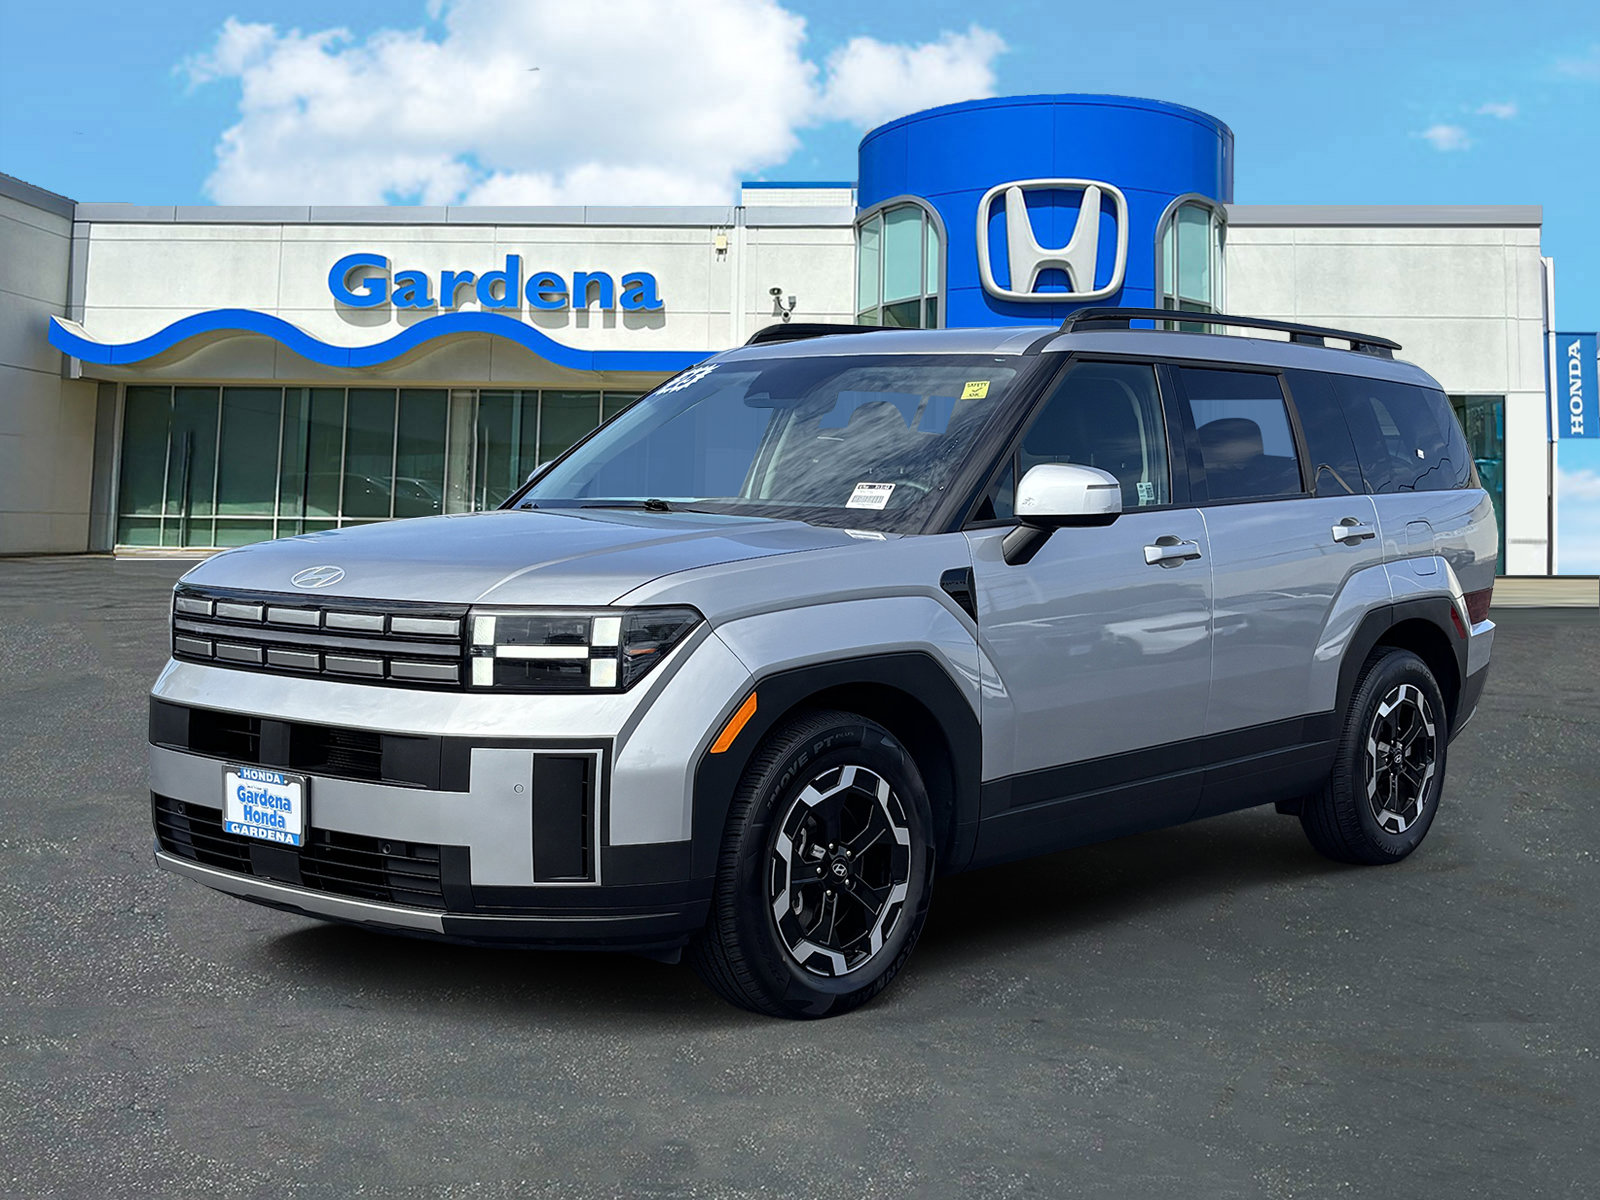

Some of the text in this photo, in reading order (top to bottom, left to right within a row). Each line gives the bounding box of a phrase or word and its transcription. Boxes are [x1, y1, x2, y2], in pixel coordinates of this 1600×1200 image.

[328, 253, 663, 310] Gardena
[1568, 339, 1585, 435] HONDA
[243, 769, 281, 784] HONDA
[236, 785, 292, 813] Gardena
[243, 804, 287, 830] Honda
[230, 823, 295, 845] GARDENA
